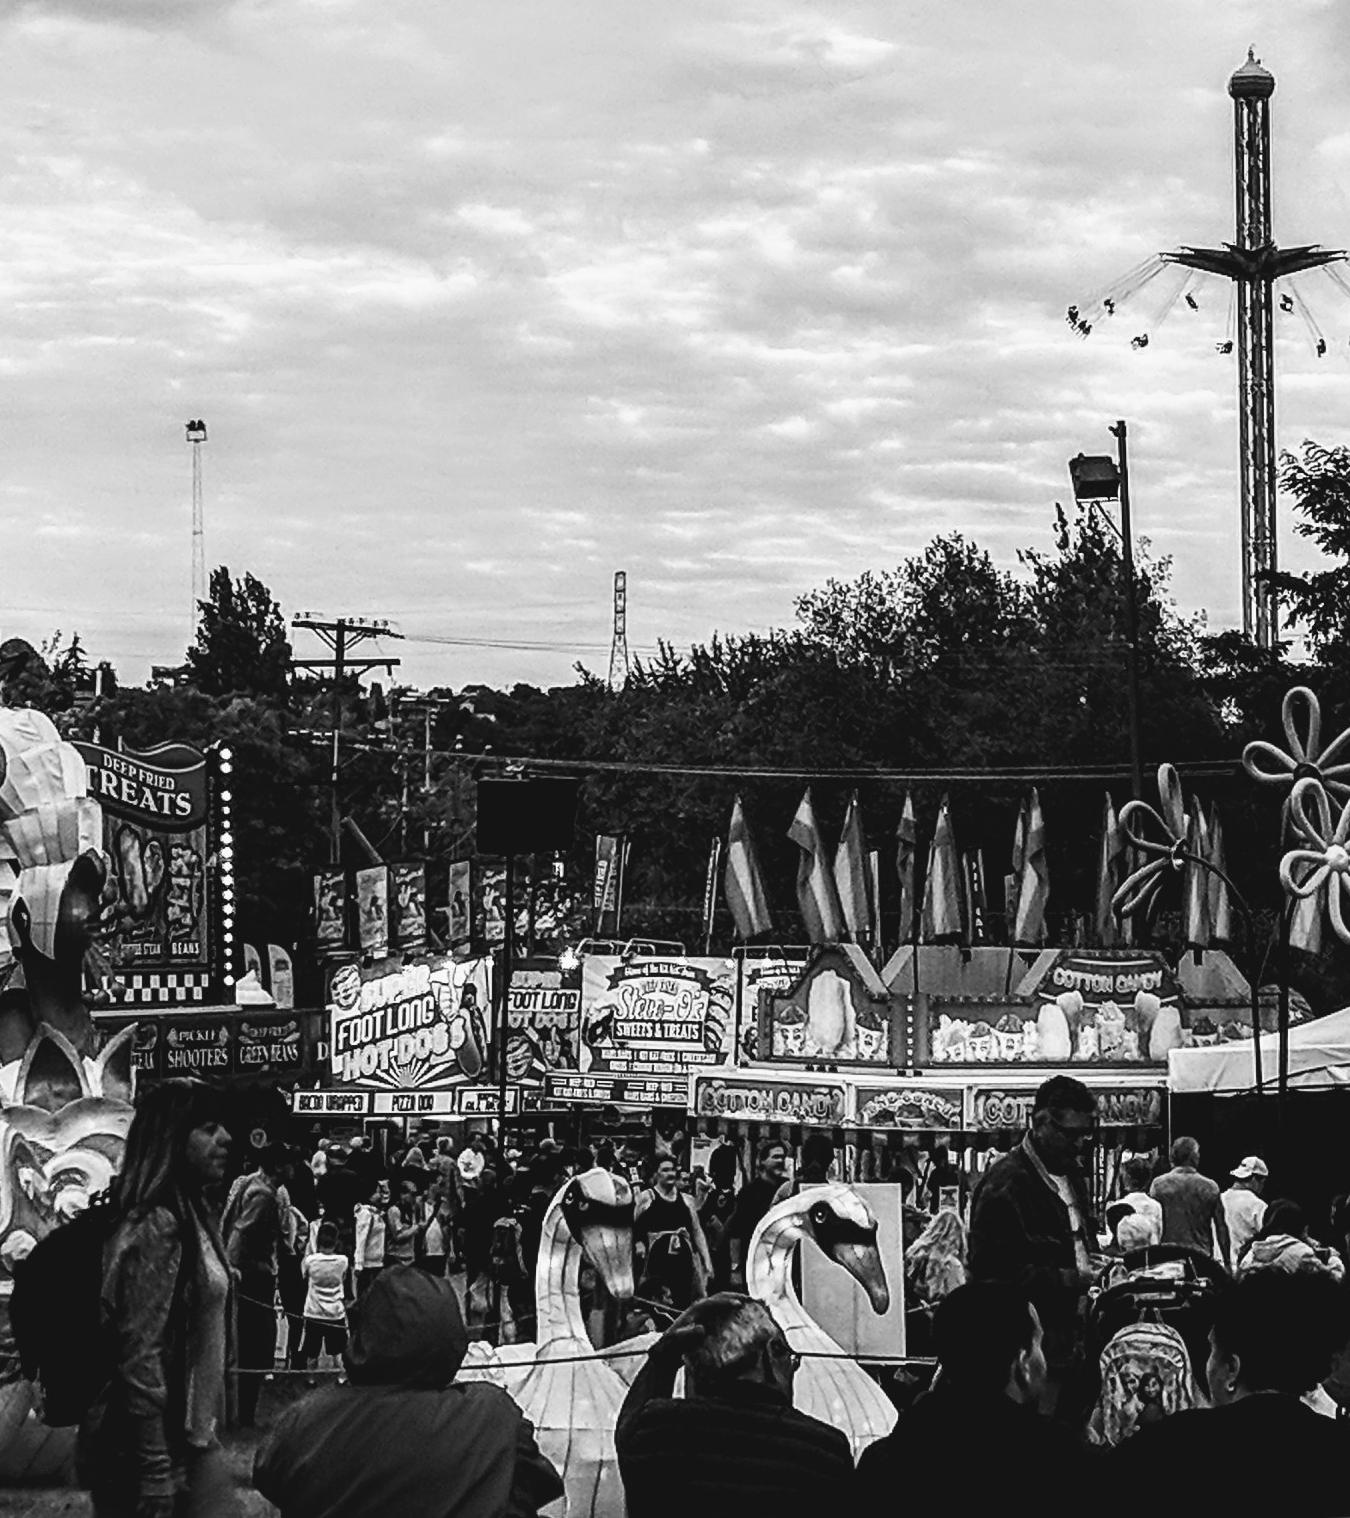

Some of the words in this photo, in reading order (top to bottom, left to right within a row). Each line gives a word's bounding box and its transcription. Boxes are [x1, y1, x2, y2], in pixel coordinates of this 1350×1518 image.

[103, 753, 137, 777] DEEP
[139, 769, 175, 790] FRIED
[86, 764, 192, 816] TREATS
[1053, 967, 1113, 993] COTTON
[1115, 969, 1163, 994] CANDY
[541, 991, 577, 1010] LONG
[338, 1009, 385, 1050] FOOT
[386, 995, 436, 1035] LONG
[616, 1021, 653, 1038] SWEETS
[655, 1023, 663, 1039] &
[663, 1023, 700, 1040] TREATS
[167, 1047, 228, 1069] SHOOTERS
[342, 1038, 394, 1082] HOT
[700, 1086, 774, 1115] COTTON
[777, 1088, 844, 1122] CANDY
